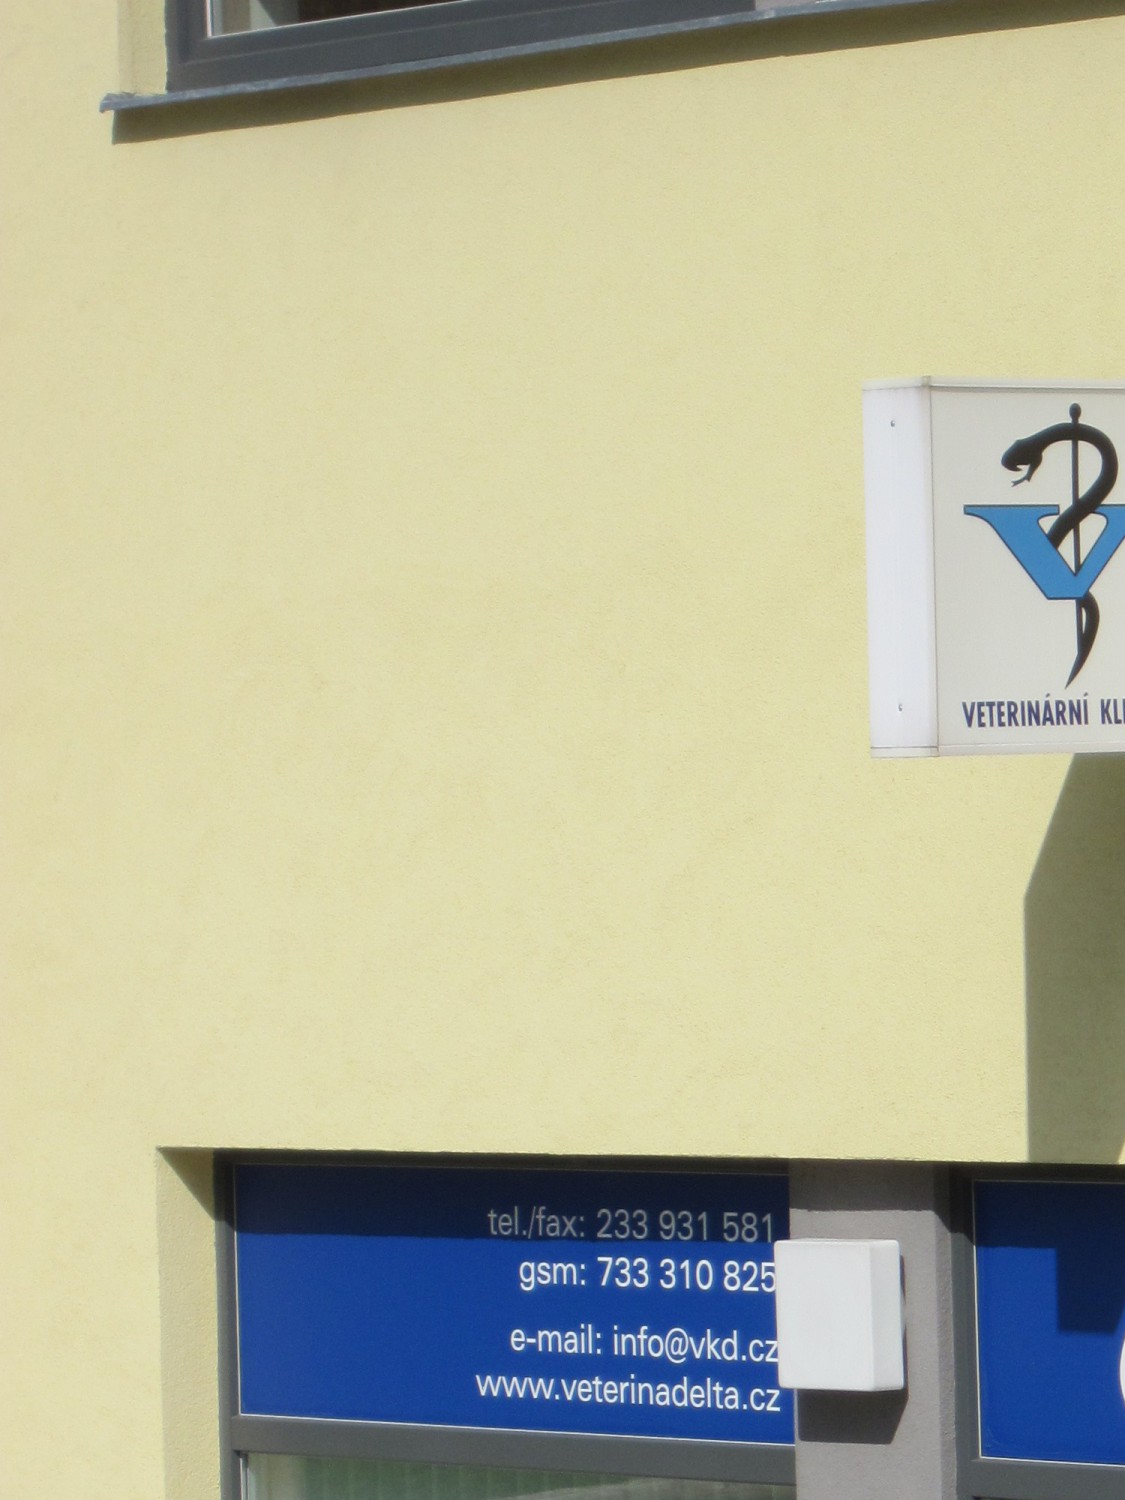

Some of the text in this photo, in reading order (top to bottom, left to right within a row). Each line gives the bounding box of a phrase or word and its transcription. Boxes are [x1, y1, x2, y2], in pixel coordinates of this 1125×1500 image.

[962, 692, 1090, 729] VETERINÁRNÍ
[487, 1206, 773, 1244] tel./fax: 233 931 581
[518, 1256, 777, 1293] gsm: 733 310 825
[510, 1323, 779, 1364] e-mail: info@vkd.cz
[475, 1373, 781, 1412] www.veterinadelta.cz
